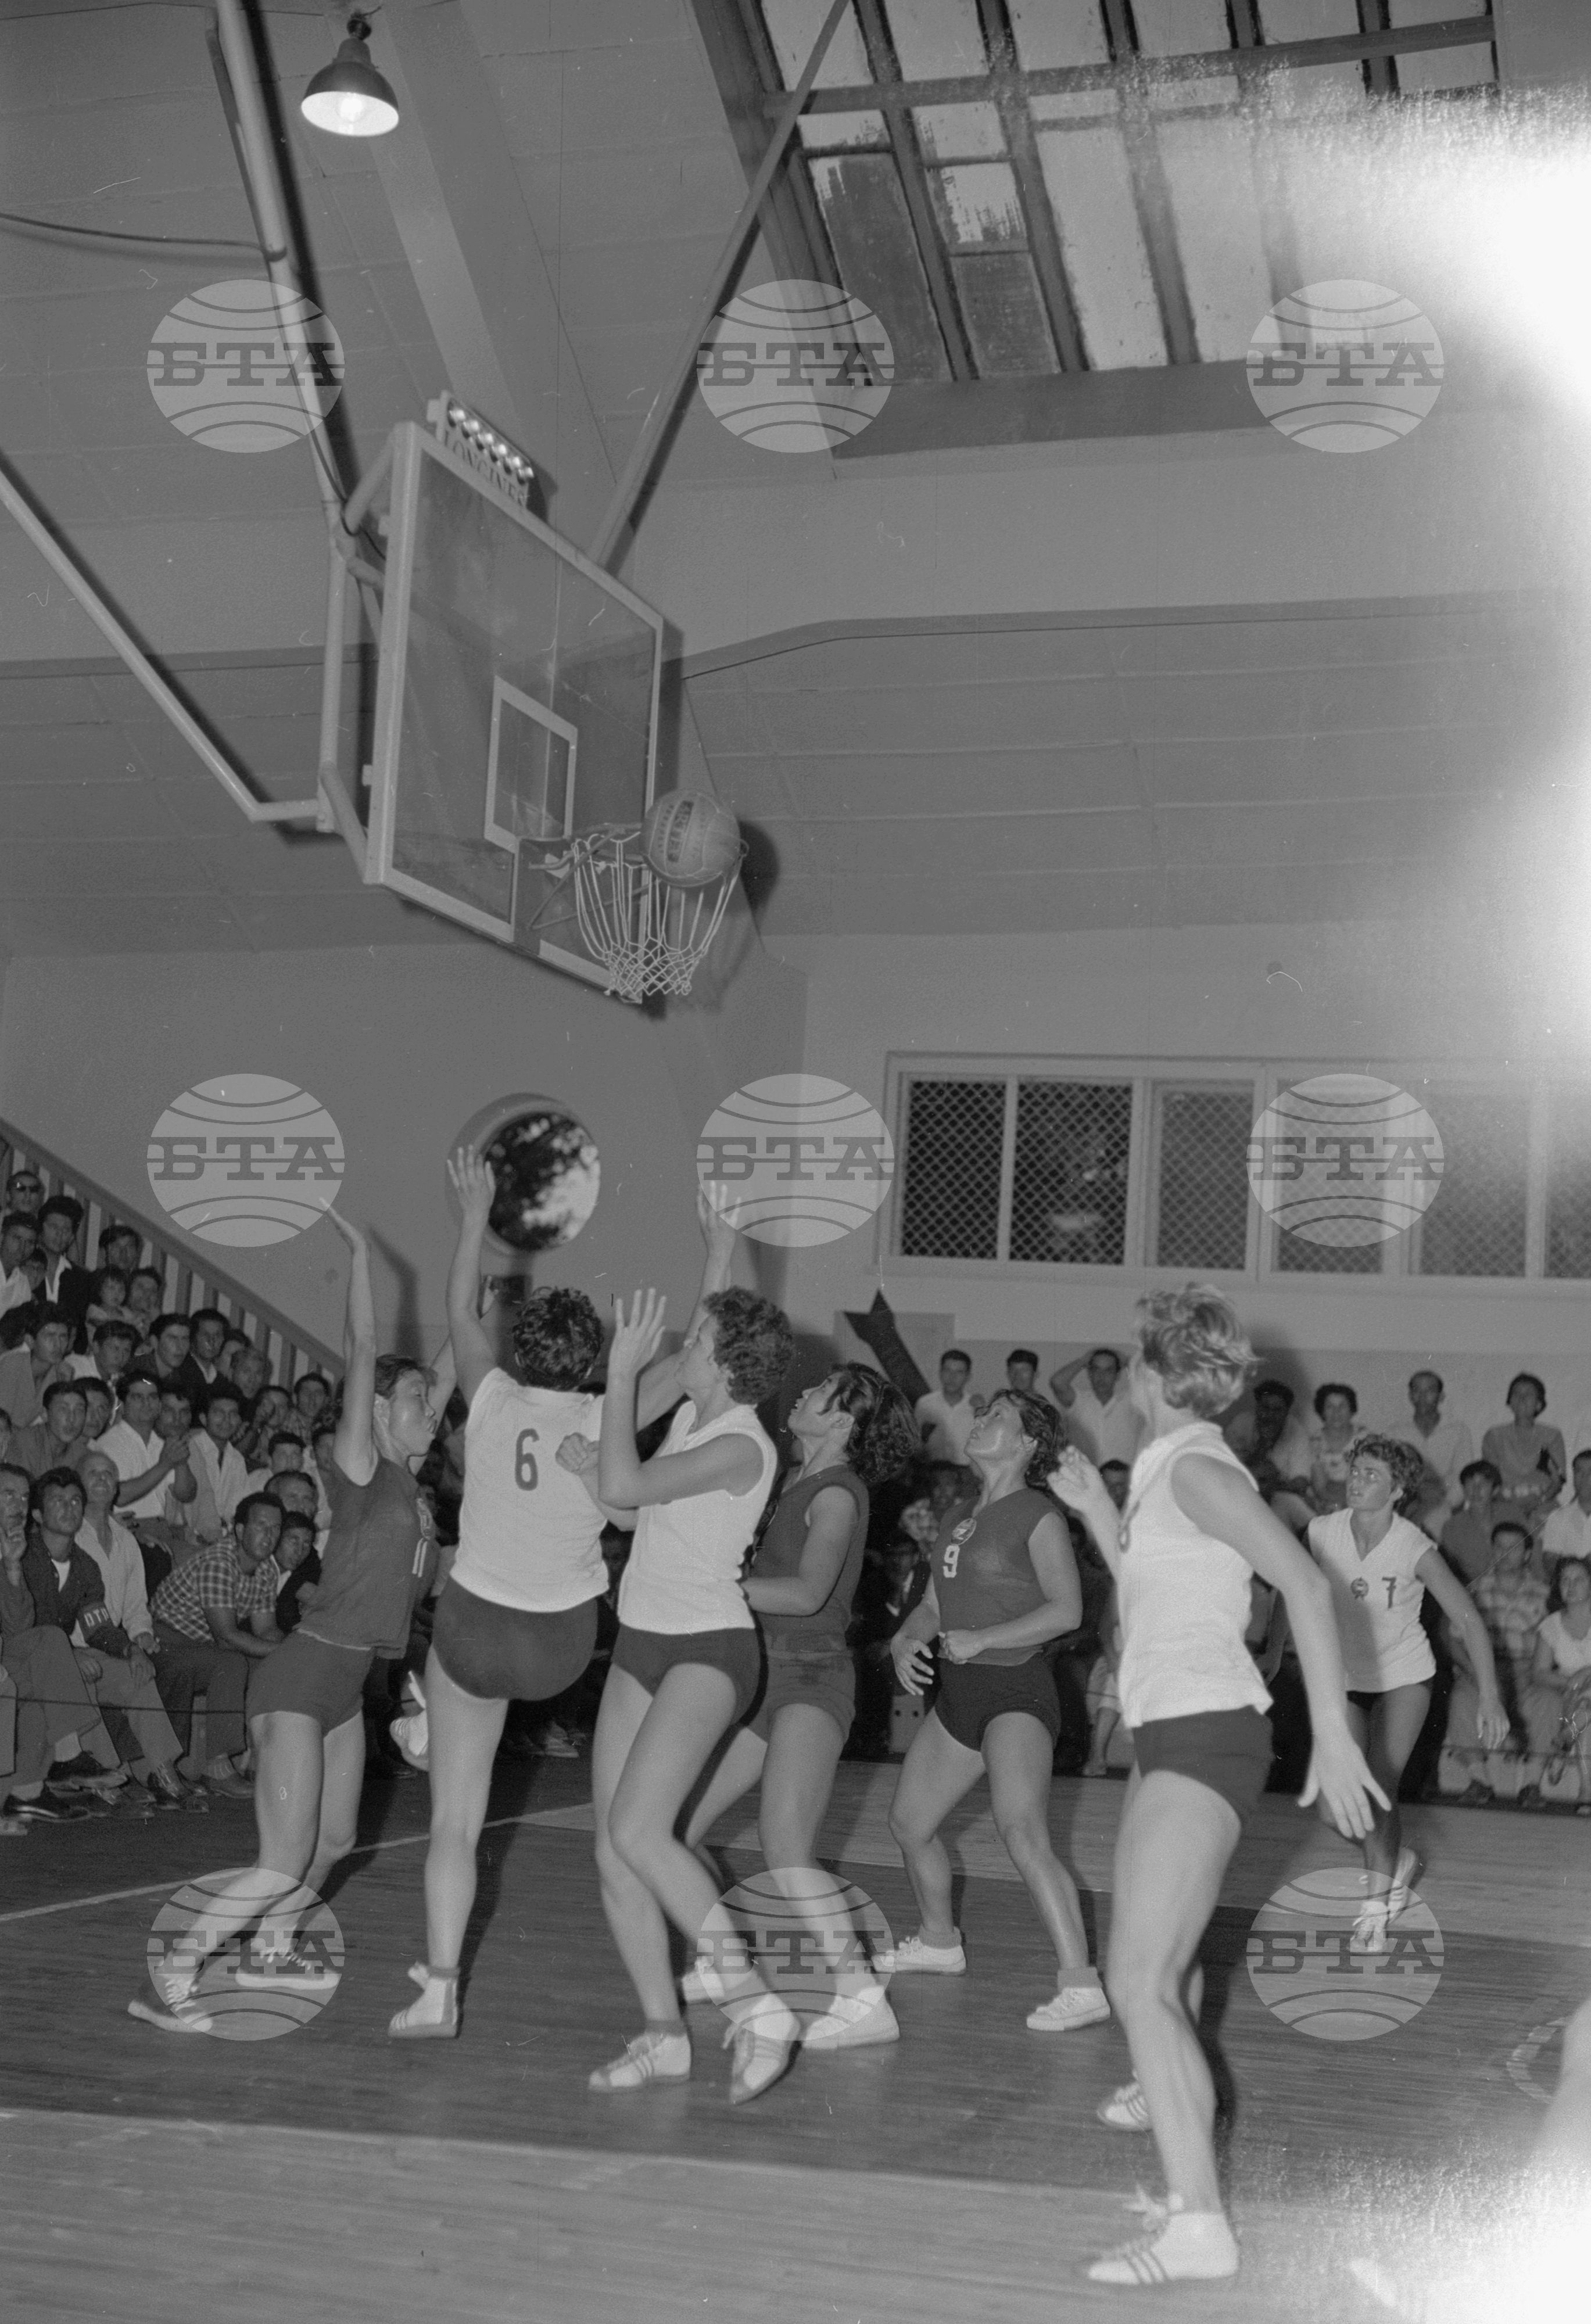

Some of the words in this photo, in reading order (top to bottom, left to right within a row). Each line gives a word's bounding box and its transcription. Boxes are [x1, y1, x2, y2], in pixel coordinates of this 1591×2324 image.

[444, 429, 525, 507] LONGINES
[515, 1428, 540, 1491] 6
[943, 1545, 960, 1579] 9
[1381, 1576, 1397, 1609] 7
